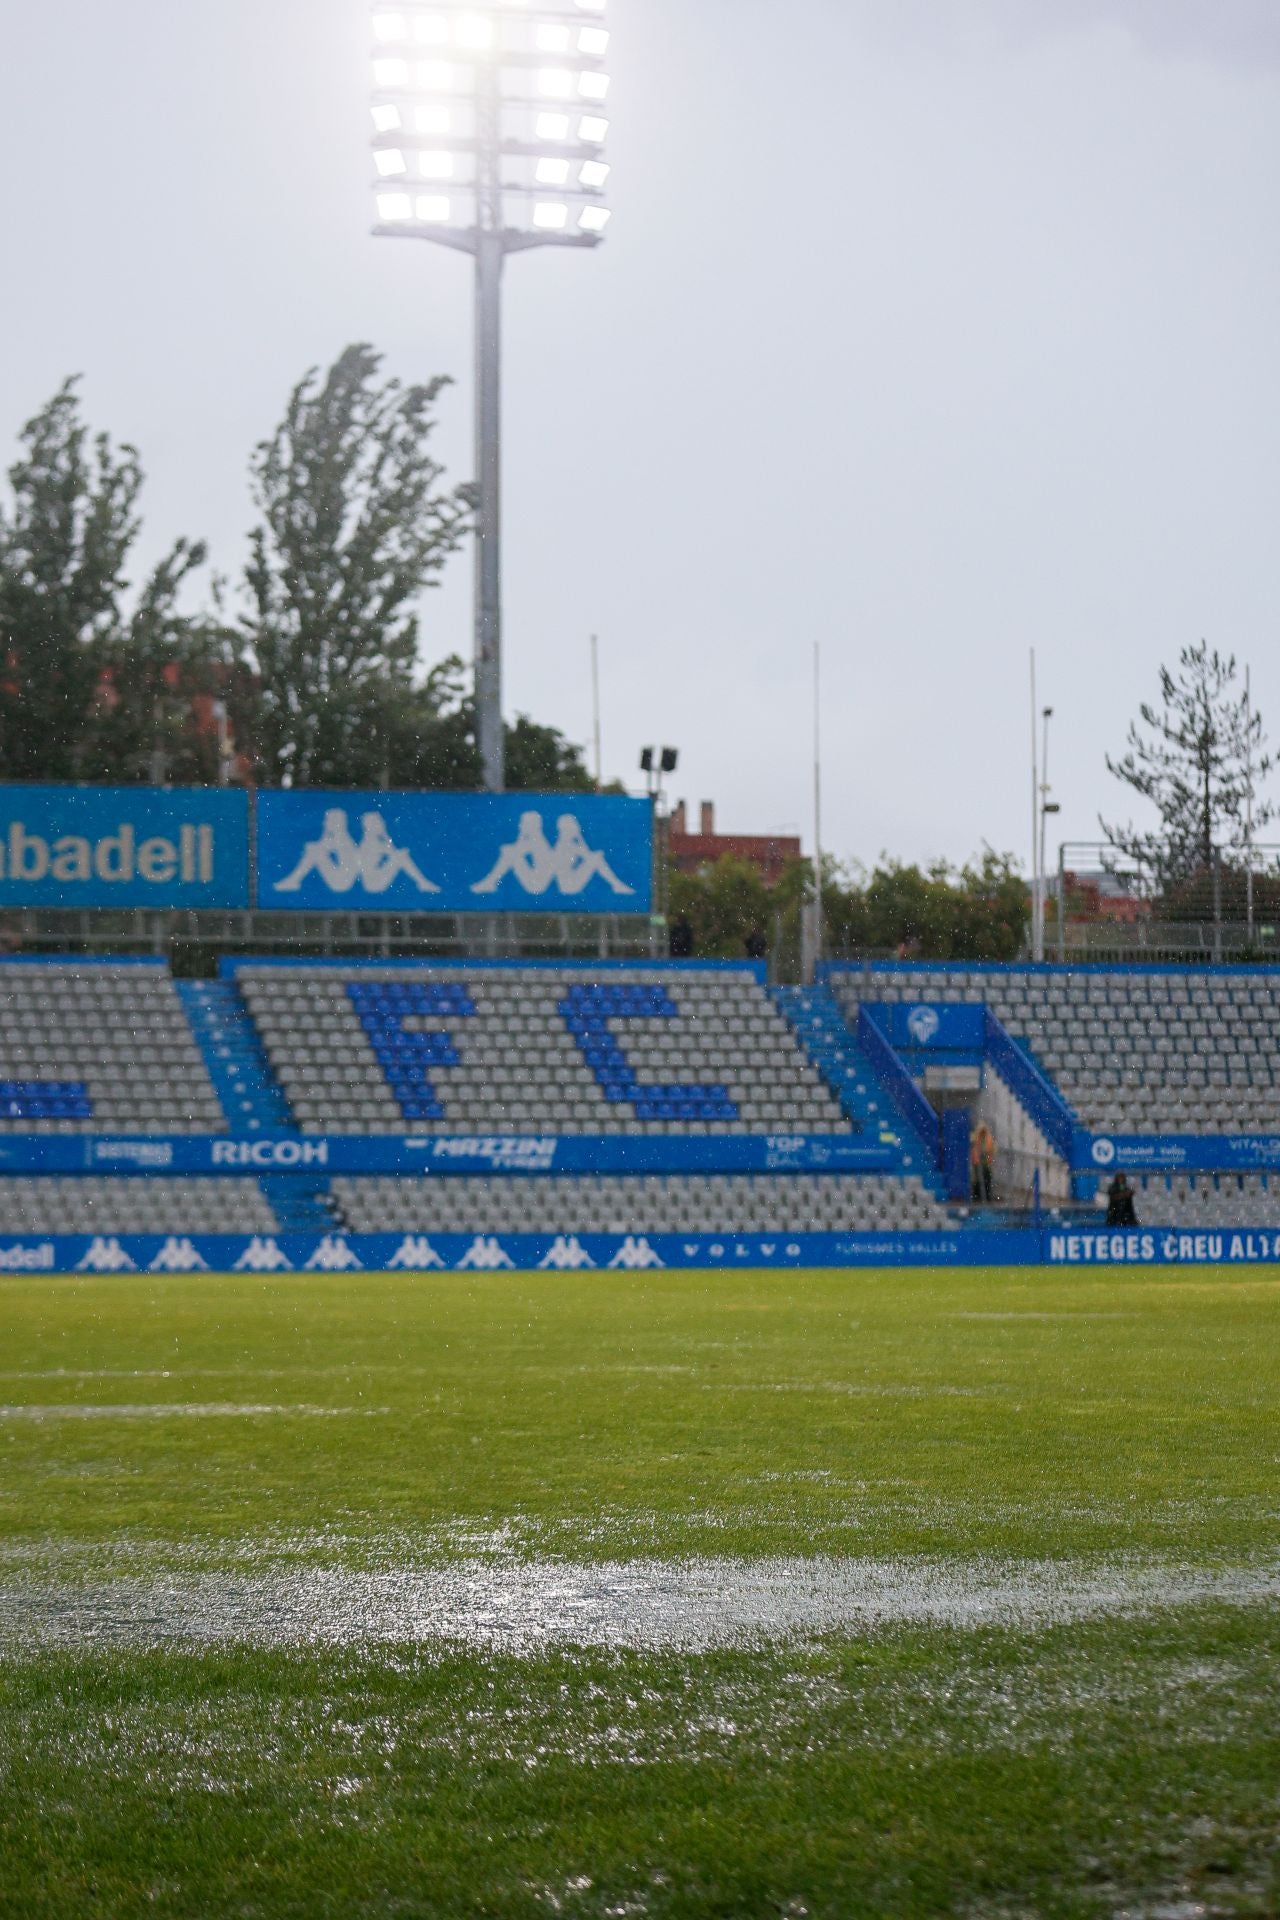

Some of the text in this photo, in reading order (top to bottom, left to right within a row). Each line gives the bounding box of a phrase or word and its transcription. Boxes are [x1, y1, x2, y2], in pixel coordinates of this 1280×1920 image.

[0, 822, 214, 883] badell
[211, 1141, 329, 1164] RICOH
[684, 1244, 801, 1257] VOLVO
[1050, 1235, 1154, 1260] NETEGES
[1164, 1235, 1222, 1259] CREU
